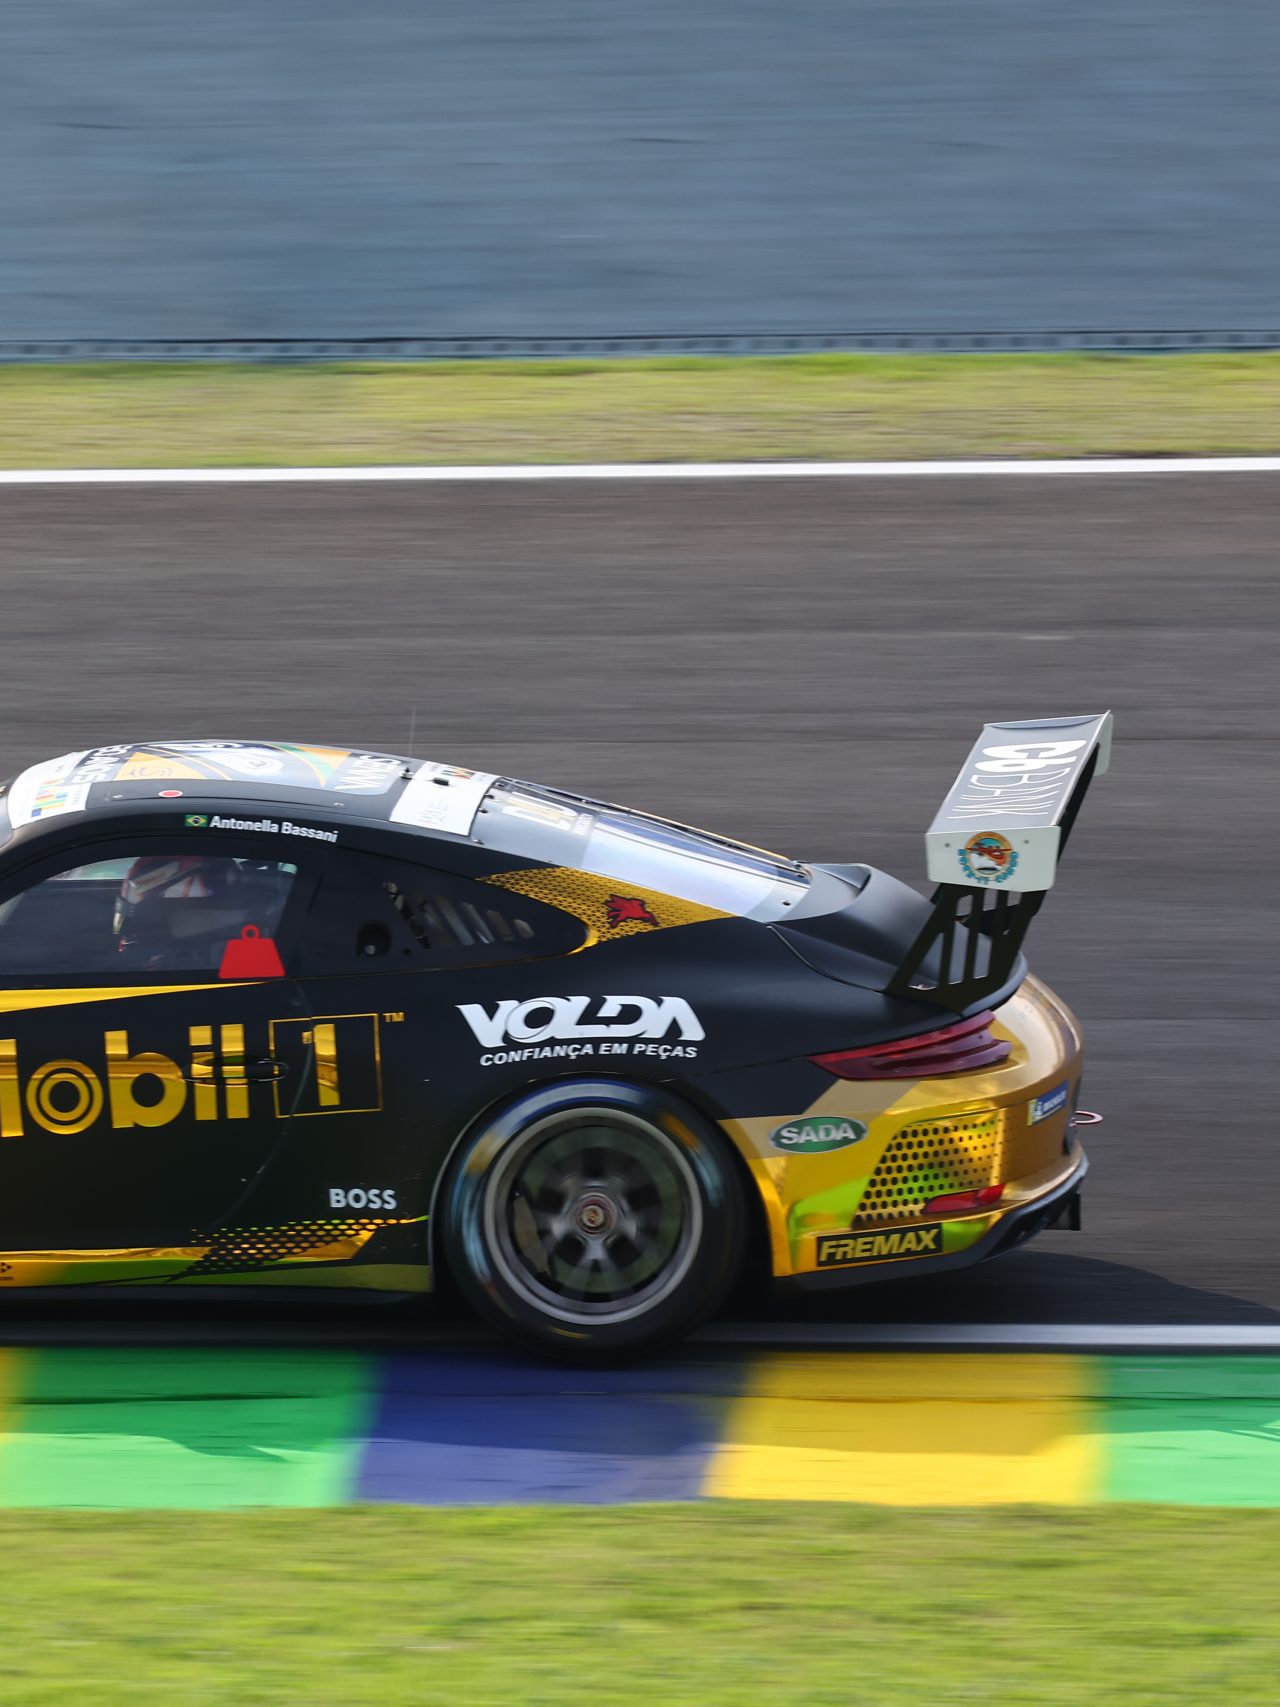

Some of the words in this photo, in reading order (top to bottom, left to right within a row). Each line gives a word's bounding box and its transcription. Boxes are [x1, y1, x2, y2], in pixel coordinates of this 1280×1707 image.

[209, 815, 279, 833] Antonella
[281, 821, 339, 843] Bassani
[454, 995, 706, 1048] VOLDA
[302, 1023, 341, 1107] 1
[479, 1043, 594, 1066] CONFIANÇA
[598, 1043, 628, 1055] EM
[632, 1043, 698, 1060] PEÇAS
[780, 1122, 857, 1145] SADA
[328, 1188, 398, 1210] BOSS
[819, 1228, 940, 1262] FREMAX
